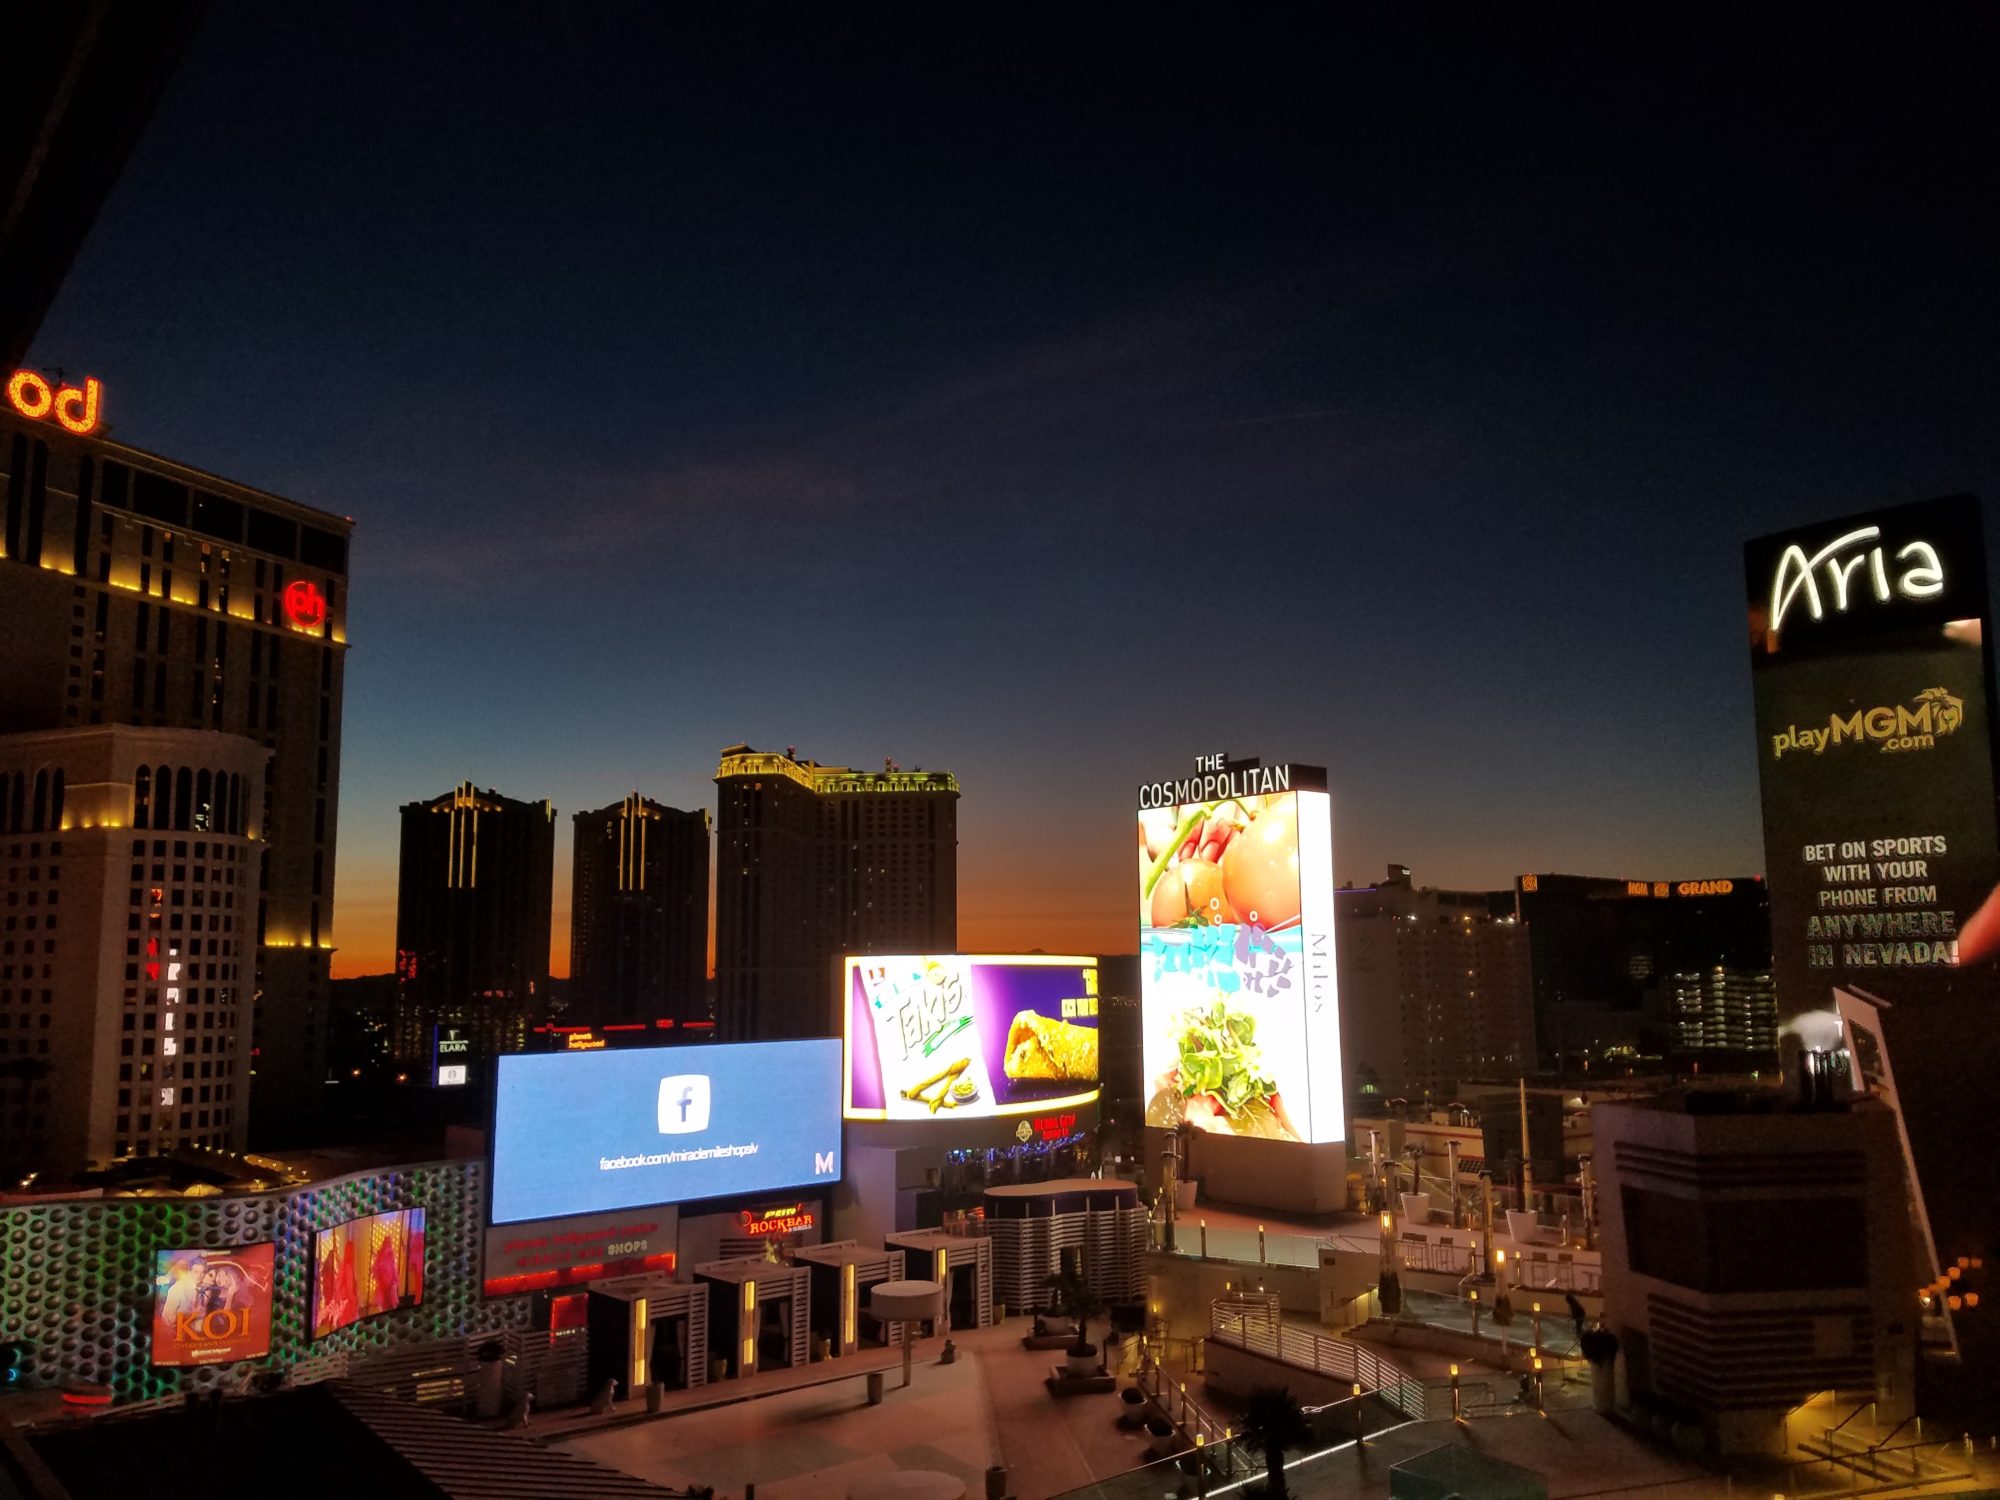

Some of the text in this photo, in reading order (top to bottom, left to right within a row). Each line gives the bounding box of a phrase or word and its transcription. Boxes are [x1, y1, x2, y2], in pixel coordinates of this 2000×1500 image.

[7, 369, 101, 435] od
[1770, 526, 1944, 631] Aria
[1773, 702, 1933, 759] playMGM
[1195, 753, 1225, 773] THE
[1139, 764, 1290, 809] COSMOPOLITAN
[1804, 835, 1947, 862] BET ON SPORTS
[1824, 860, 1928, 882] WITH YOUR
[1678, 880, 1733, 896] GRAND
[1819, 885, 1937, 907] PHONE FROM
[1807, 910, 1957, 939] ANYWHERE
[1808, 944, 1834, 967] IN
[439, 1044, 467, 1053] ELARA
[815, 1151, 834, 1175] M
[749, 1214, 812, 1234] ROCKBAR
[607, 1239, 648, 1256] SHOPS
[175, 1307, 252, 1342] KOI
